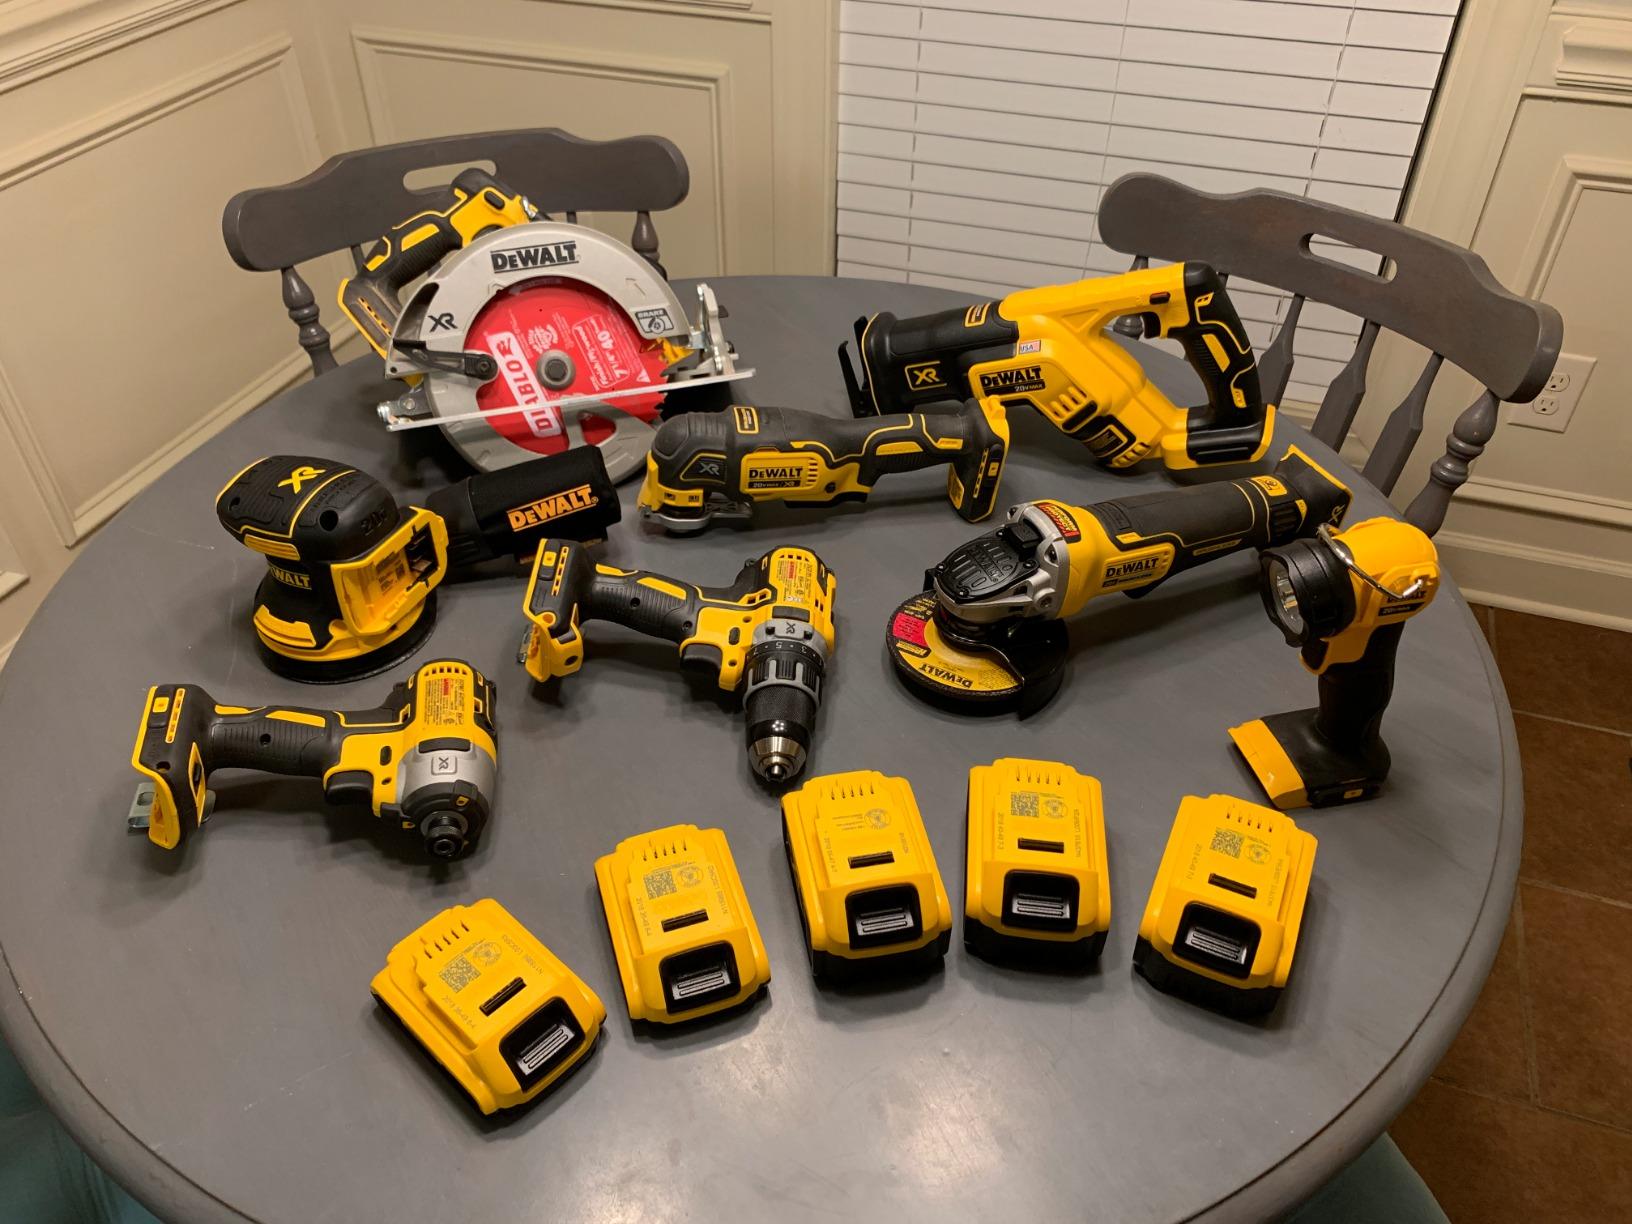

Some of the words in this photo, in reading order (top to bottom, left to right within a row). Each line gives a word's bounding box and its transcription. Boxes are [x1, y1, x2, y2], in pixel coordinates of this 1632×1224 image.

[490, 243, 577, 271] DEWALT
[427, 312, 458, 332] XR
[597, 329, 615, 350] 40
[1020, 344, 1034, 353] USA
[913, 368, 940, 385] XR
[980, 367, 1041, 388] DEWALT
[504, 359, 553, 432] DIABLO
[700, 462, 719, 476] XR
[749, 468, 803, 479] DEWALT
[277, 466, 326, 494] XR
[507, 486, 592, 530] DEWALT
[1328, 505, 1345, 523] XR
[1106, 558, 1159, 577] DEWALT
[786, 622, 795, 634] XR
[775, 641, 783, 649] 5
[920, 664, 973, 688] DEWALT
[439, 757, 449, 769] XR
